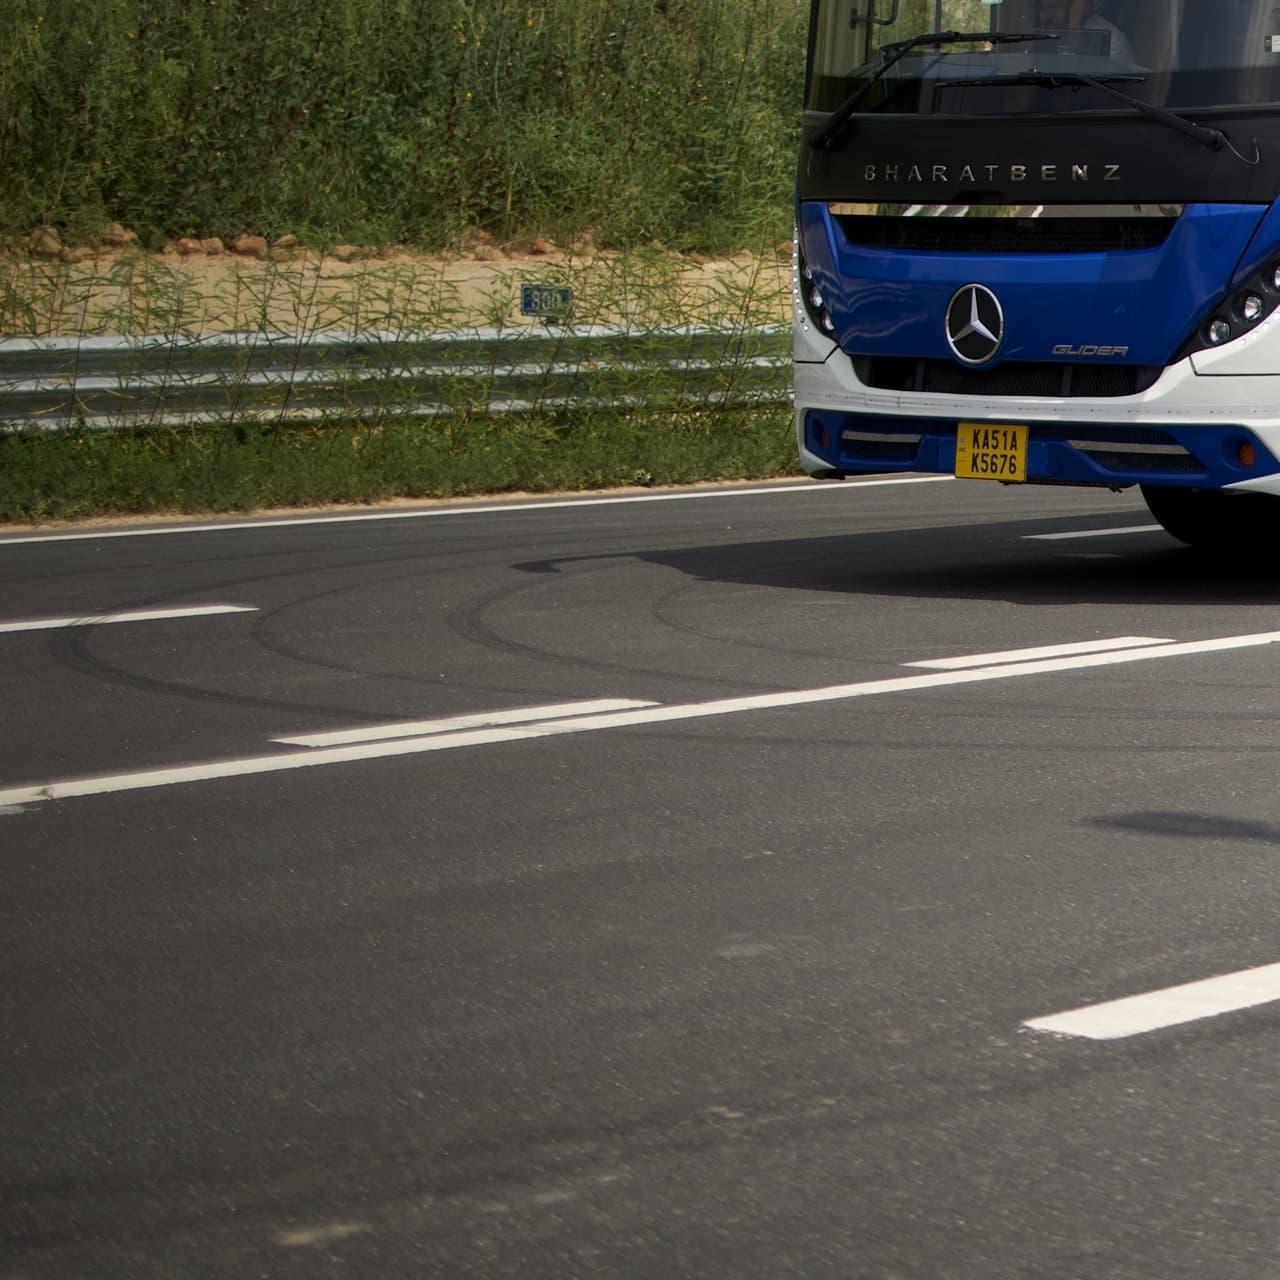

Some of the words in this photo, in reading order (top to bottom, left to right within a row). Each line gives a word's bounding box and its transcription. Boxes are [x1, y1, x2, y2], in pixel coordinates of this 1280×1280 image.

[863, 164, 1121, 182] BHARATBENZ
[1052, 344, 1129, 357] GLIDER
[972, 428, 1017, 451] KA51A
[971, 452, 1017, 474] K5676
